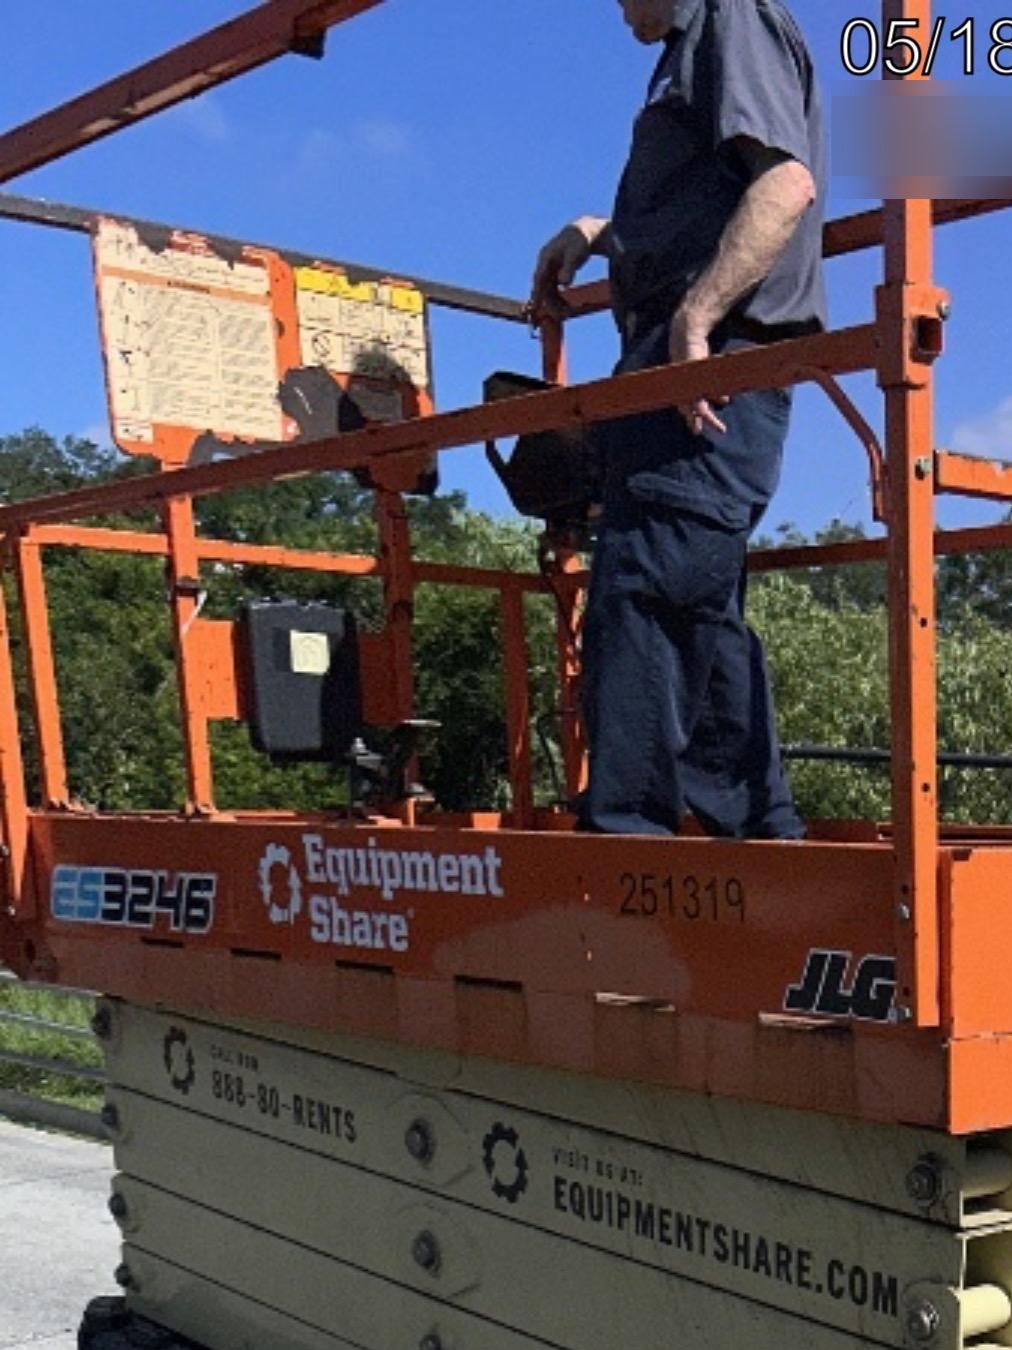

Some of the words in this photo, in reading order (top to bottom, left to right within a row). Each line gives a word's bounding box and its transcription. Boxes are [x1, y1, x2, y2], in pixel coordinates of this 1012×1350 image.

[52, 865, 215, 932] ES3246
[303, 833, 503, 899] Equipment
[619, 872, 746, 922] 251319
[309, 897, 410, 952] Share
[785, 948, 896, 1022] JLG
[553, 1174, 899, 1317] EQUIPMENTSHARE.COM
